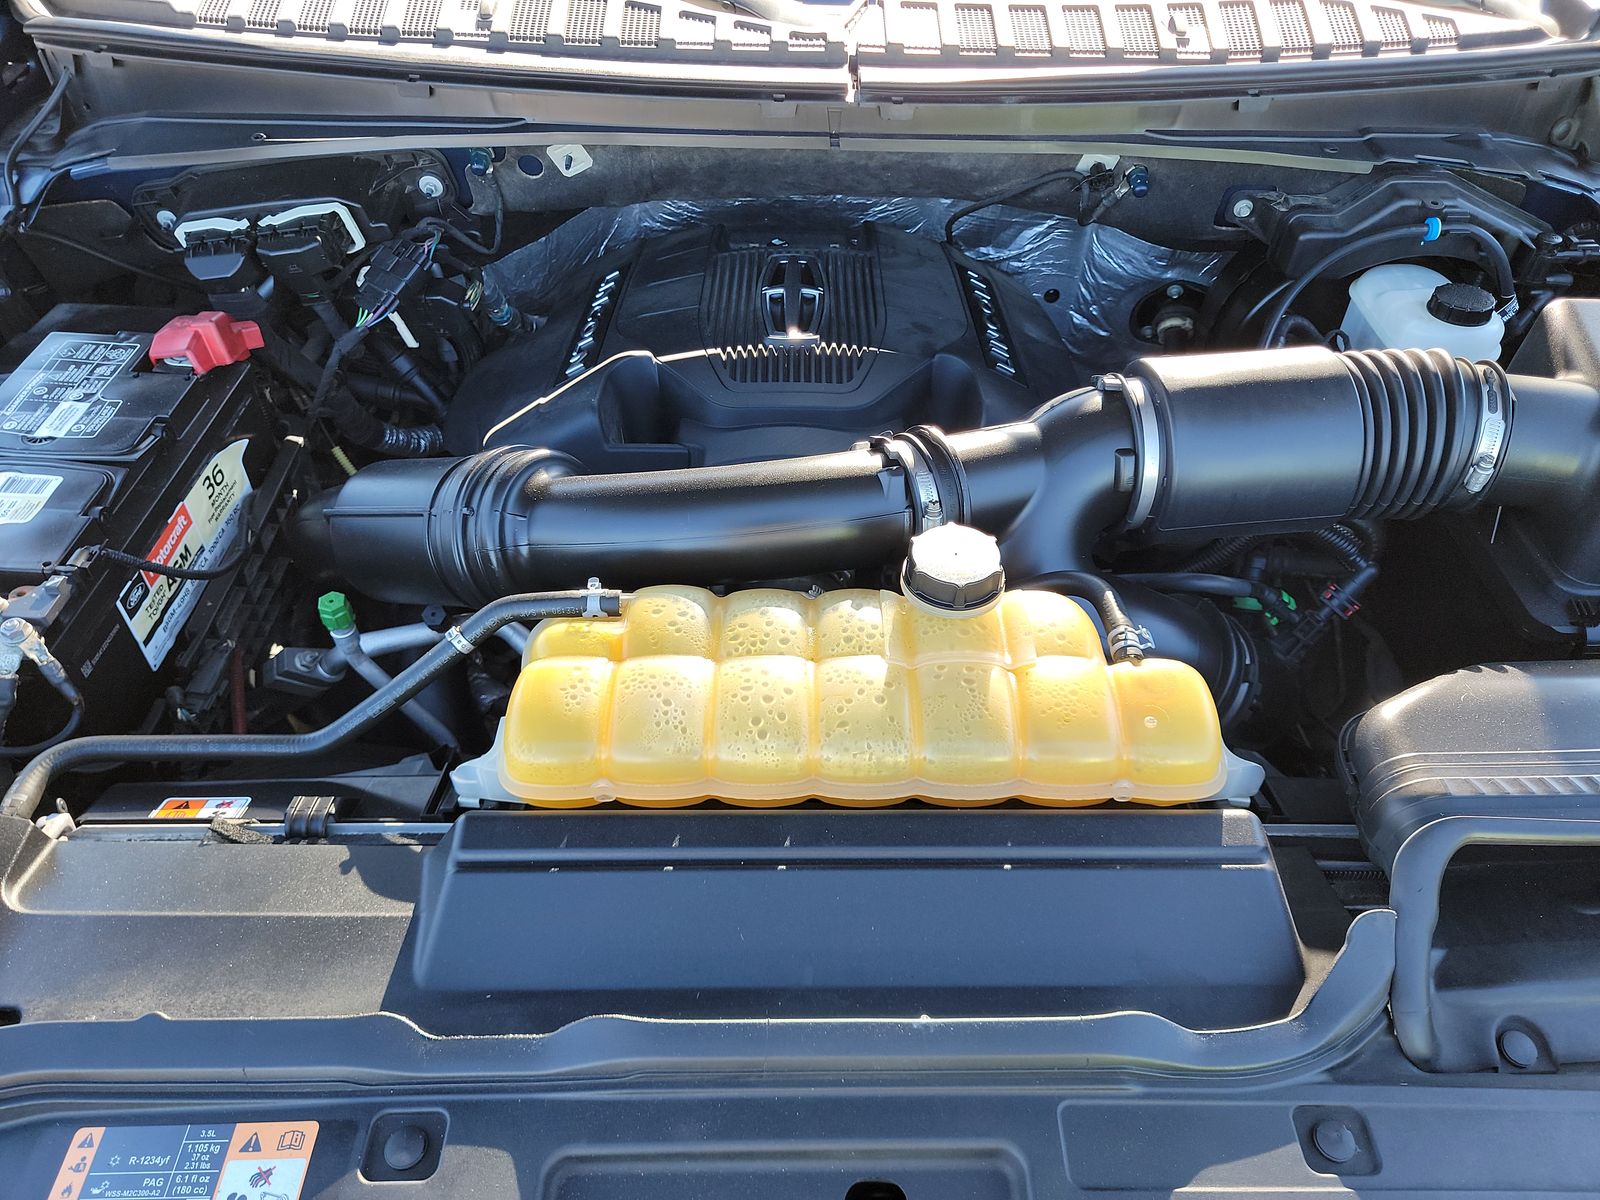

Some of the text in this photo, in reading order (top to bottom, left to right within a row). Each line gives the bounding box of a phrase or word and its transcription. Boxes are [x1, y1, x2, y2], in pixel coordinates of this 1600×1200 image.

[565, 271, 619, 377] LINCOLN
[967, 271, 1016, 376] LINCOLN
[202, 463, 225, 500] 36
[211, 482, 229, 507] MONTH
[149, 514, 187, 577] otorcraft
[146, 584, 163, 613] TESTED
[200, 1129, 216, 1138] 3.5L
[187, 1143, 220, 1153] 1.105 kg
[128, 1155, 171, 1167] R-1234yf
[184, 1161, 211, 1169] 2.31 lbs
[142, 1178, 164, 1187] PAG
[175, 1174, 211, 1183] 6.1 fl oz
[105, 1189, 161, 1198] WSS-M2C300-A2
[172, 1185, 208, 1196] (180 cc)
